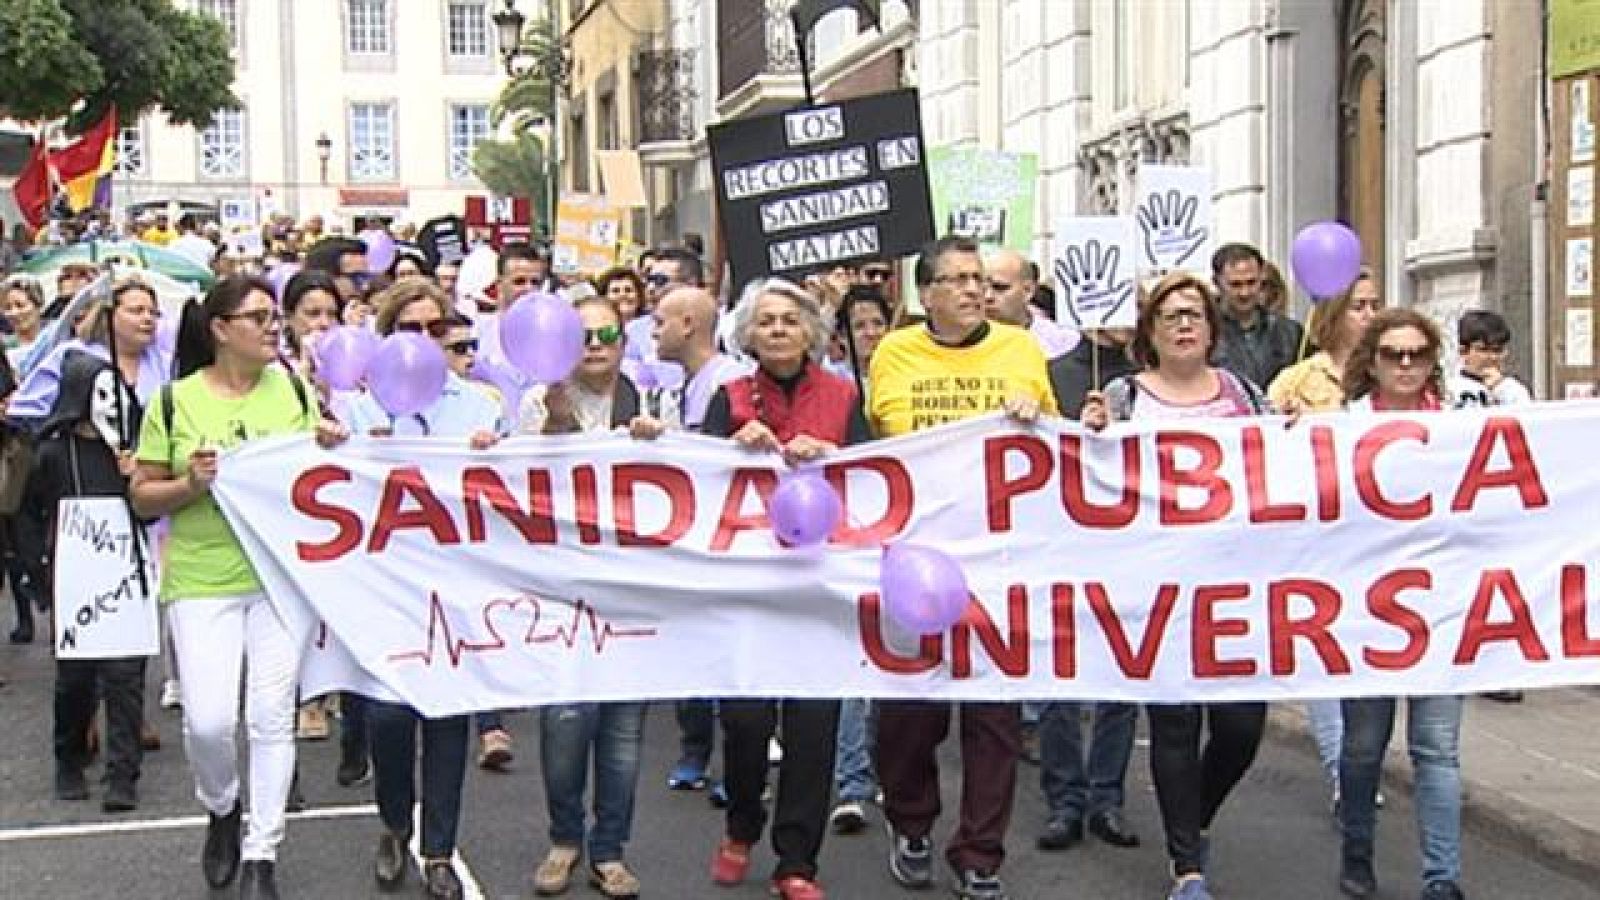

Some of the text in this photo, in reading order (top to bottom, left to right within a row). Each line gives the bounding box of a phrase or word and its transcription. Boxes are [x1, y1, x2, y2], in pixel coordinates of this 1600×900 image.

[787, 111, 842, 143] LOS
[727, 138, 918, 196] RECORTES EN
[763, 184, 888, 226] SANIDAD
[773, 228, 877, 265] MATAN
[911, 377, 950, 392] QUE
[954, 377, 981, 391] NO
[911, 394, 977, 409] ROBEN
[291, 416, 1548, 562] SANIDAD PUBLICA
[859, 564, 1600, 680] UNIVERSAL
